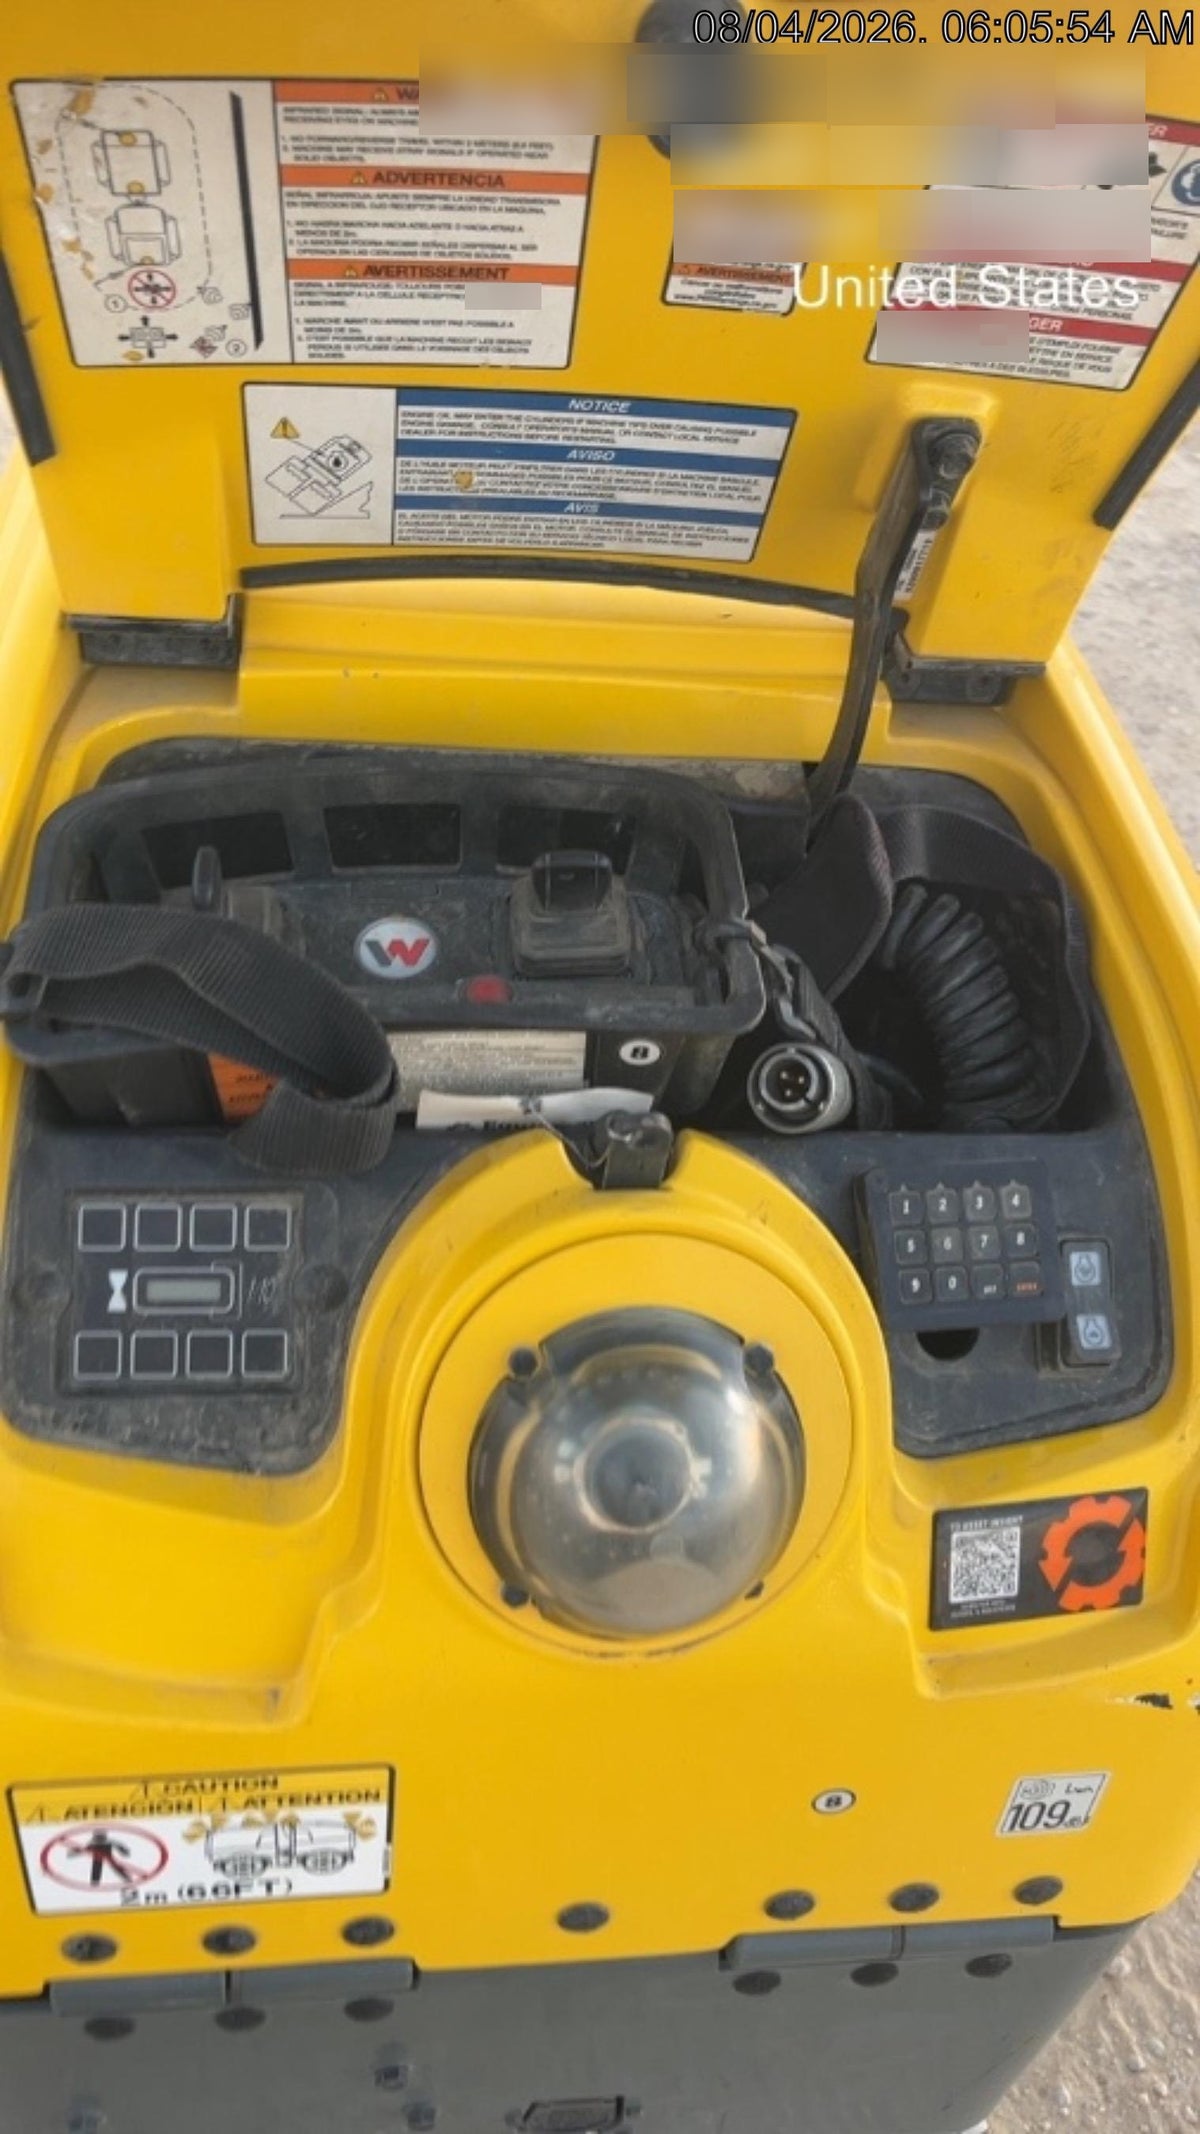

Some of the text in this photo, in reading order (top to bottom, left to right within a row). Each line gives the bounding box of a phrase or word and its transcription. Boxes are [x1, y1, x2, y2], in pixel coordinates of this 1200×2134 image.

[372, 170, 506, 189] ADVERTENCIA
[362, 264, 511, 281] AVERTISSEMENT
[568, 397, 632, 414] NOTICE
[565, 448, 616, 462] AVISO
[562, 501, 599, 514] AVIS
[903, 1193, 1021, 1214] 1 2 3 4
[907, 1231, 1026, 1253] 5 6 7 8
[911, 1277, 921, 1293] 9
[948, 1275, 957, 1290] 0
[163, 1775, 279, 1797] CAUTION
[242, 1790, 381, 1811] ATTENTION
[1008, 1799, 1070, 1832] 109
